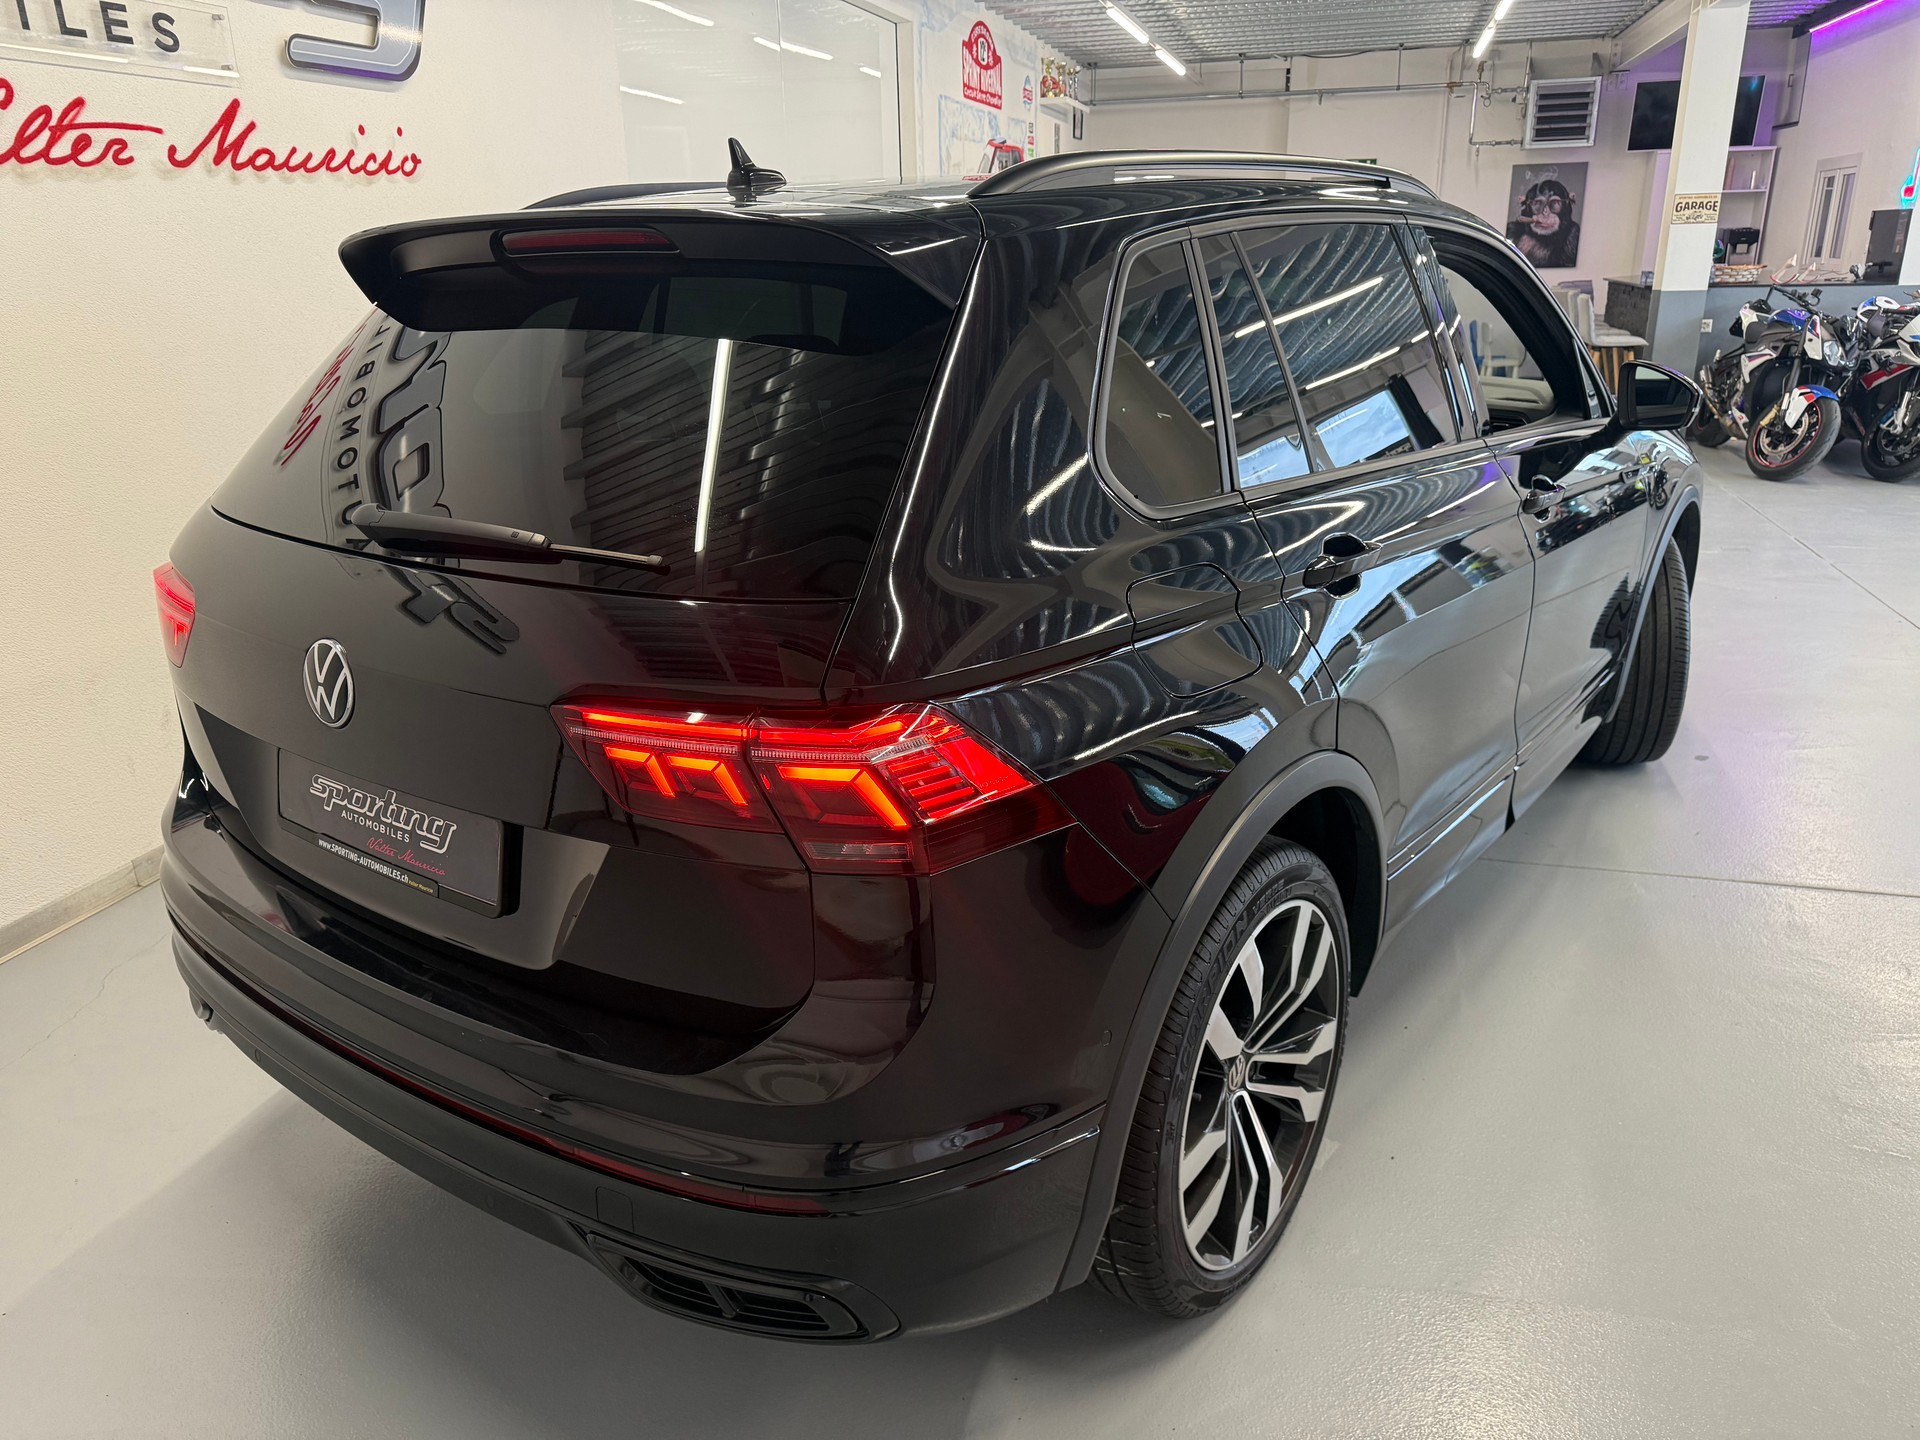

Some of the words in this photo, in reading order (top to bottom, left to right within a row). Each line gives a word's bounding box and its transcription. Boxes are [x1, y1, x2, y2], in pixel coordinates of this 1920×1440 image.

[0, 78, 164, 168] lter
[167, 97, 422, 177] Mauricio
[1676, 201, 1718, 213] GARAGE
[309, 773, 457, 854] sporting
[341, 809, 411, 843] AUTOMOBILES
[318, 838, 409, 885] www.SPORTING-AUTOMOBILES.ch
